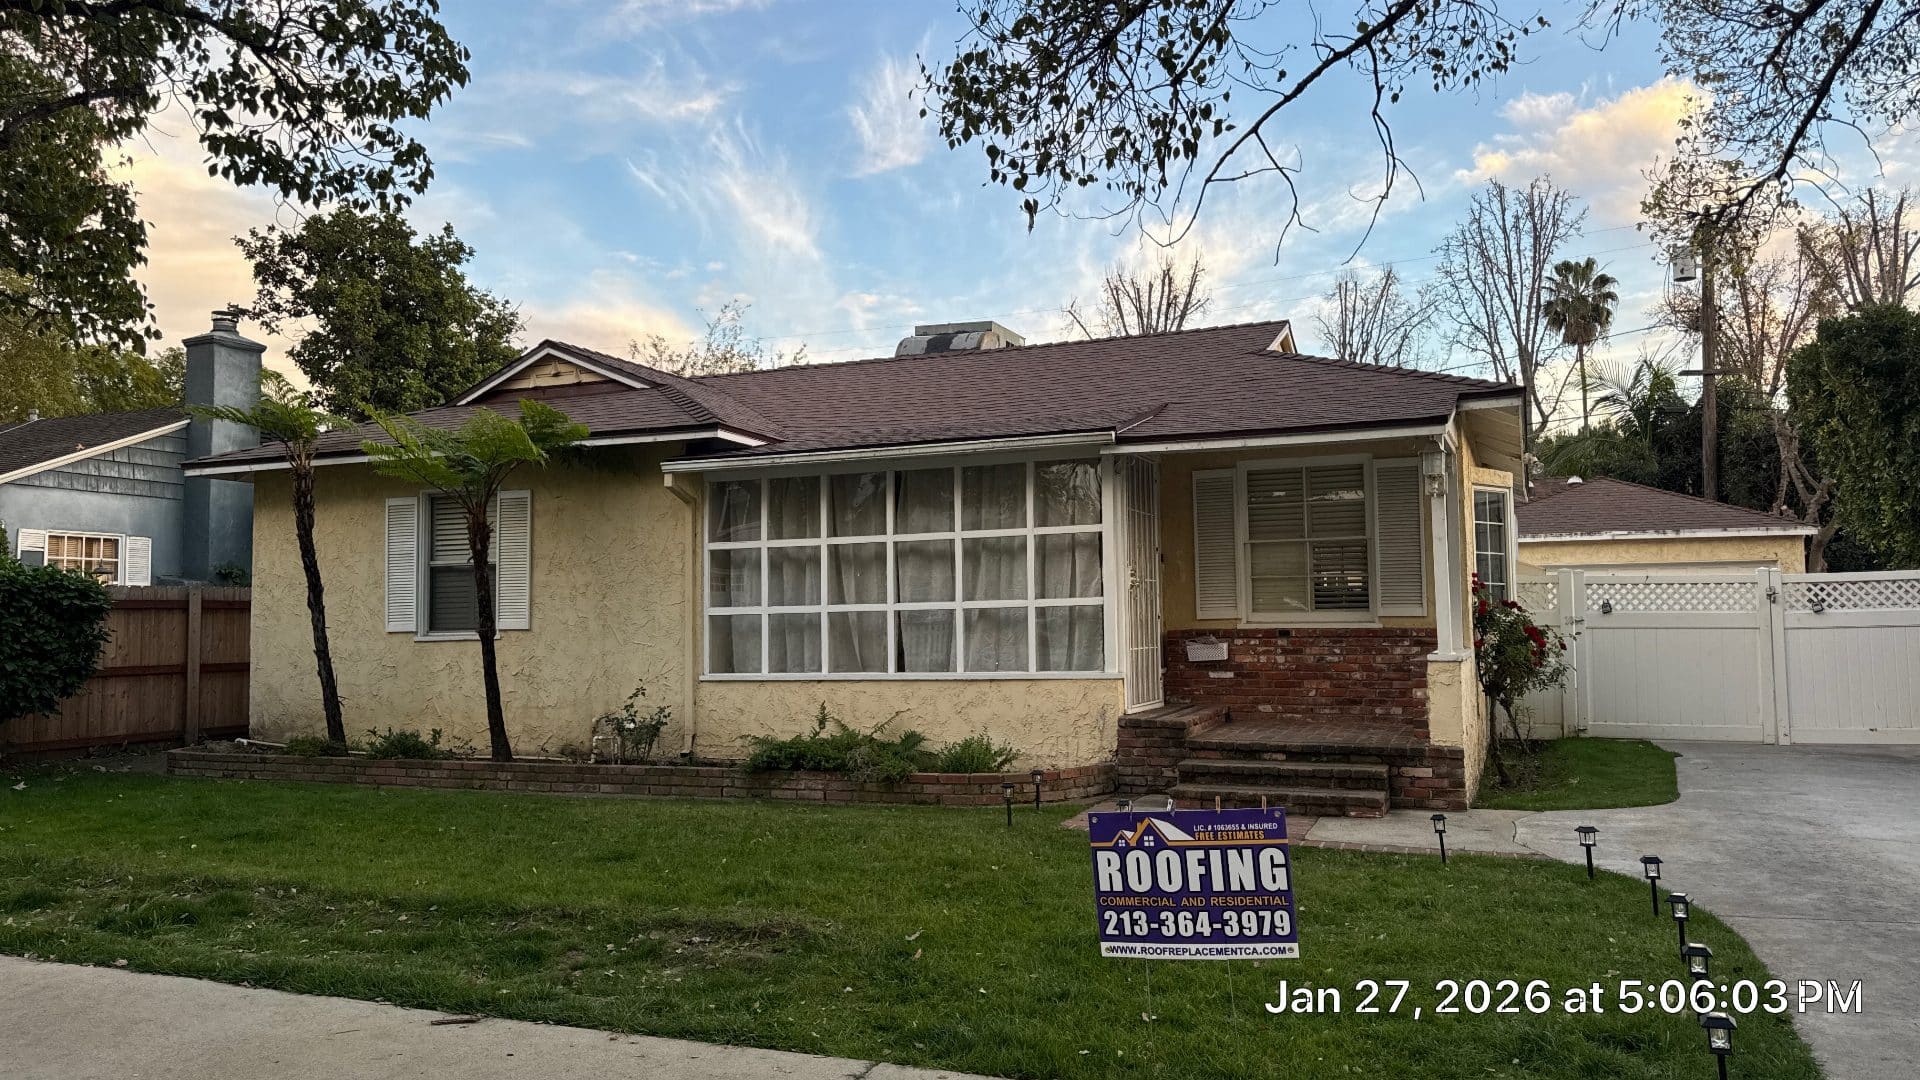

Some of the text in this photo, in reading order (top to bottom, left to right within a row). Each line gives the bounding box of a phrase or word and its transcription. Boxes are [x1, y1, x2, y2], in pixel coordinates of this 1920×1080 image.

[1193, 824, 1207, 832] LIC.
[1247, 822, 1278, 830] INSURED
[1195, 830, 1265, 841] FREE ESTIMATES
[1096, 847, 1289, 893] ROOFING
[1100, 896, 1289, 907] COMMERCIAL AND RESIDENTIAL
[1103, 910, 1291, 937] 213-364-3979
[1111, 945, 1287, 956] WWW.ROOFREPLACEMENTCA.COM
